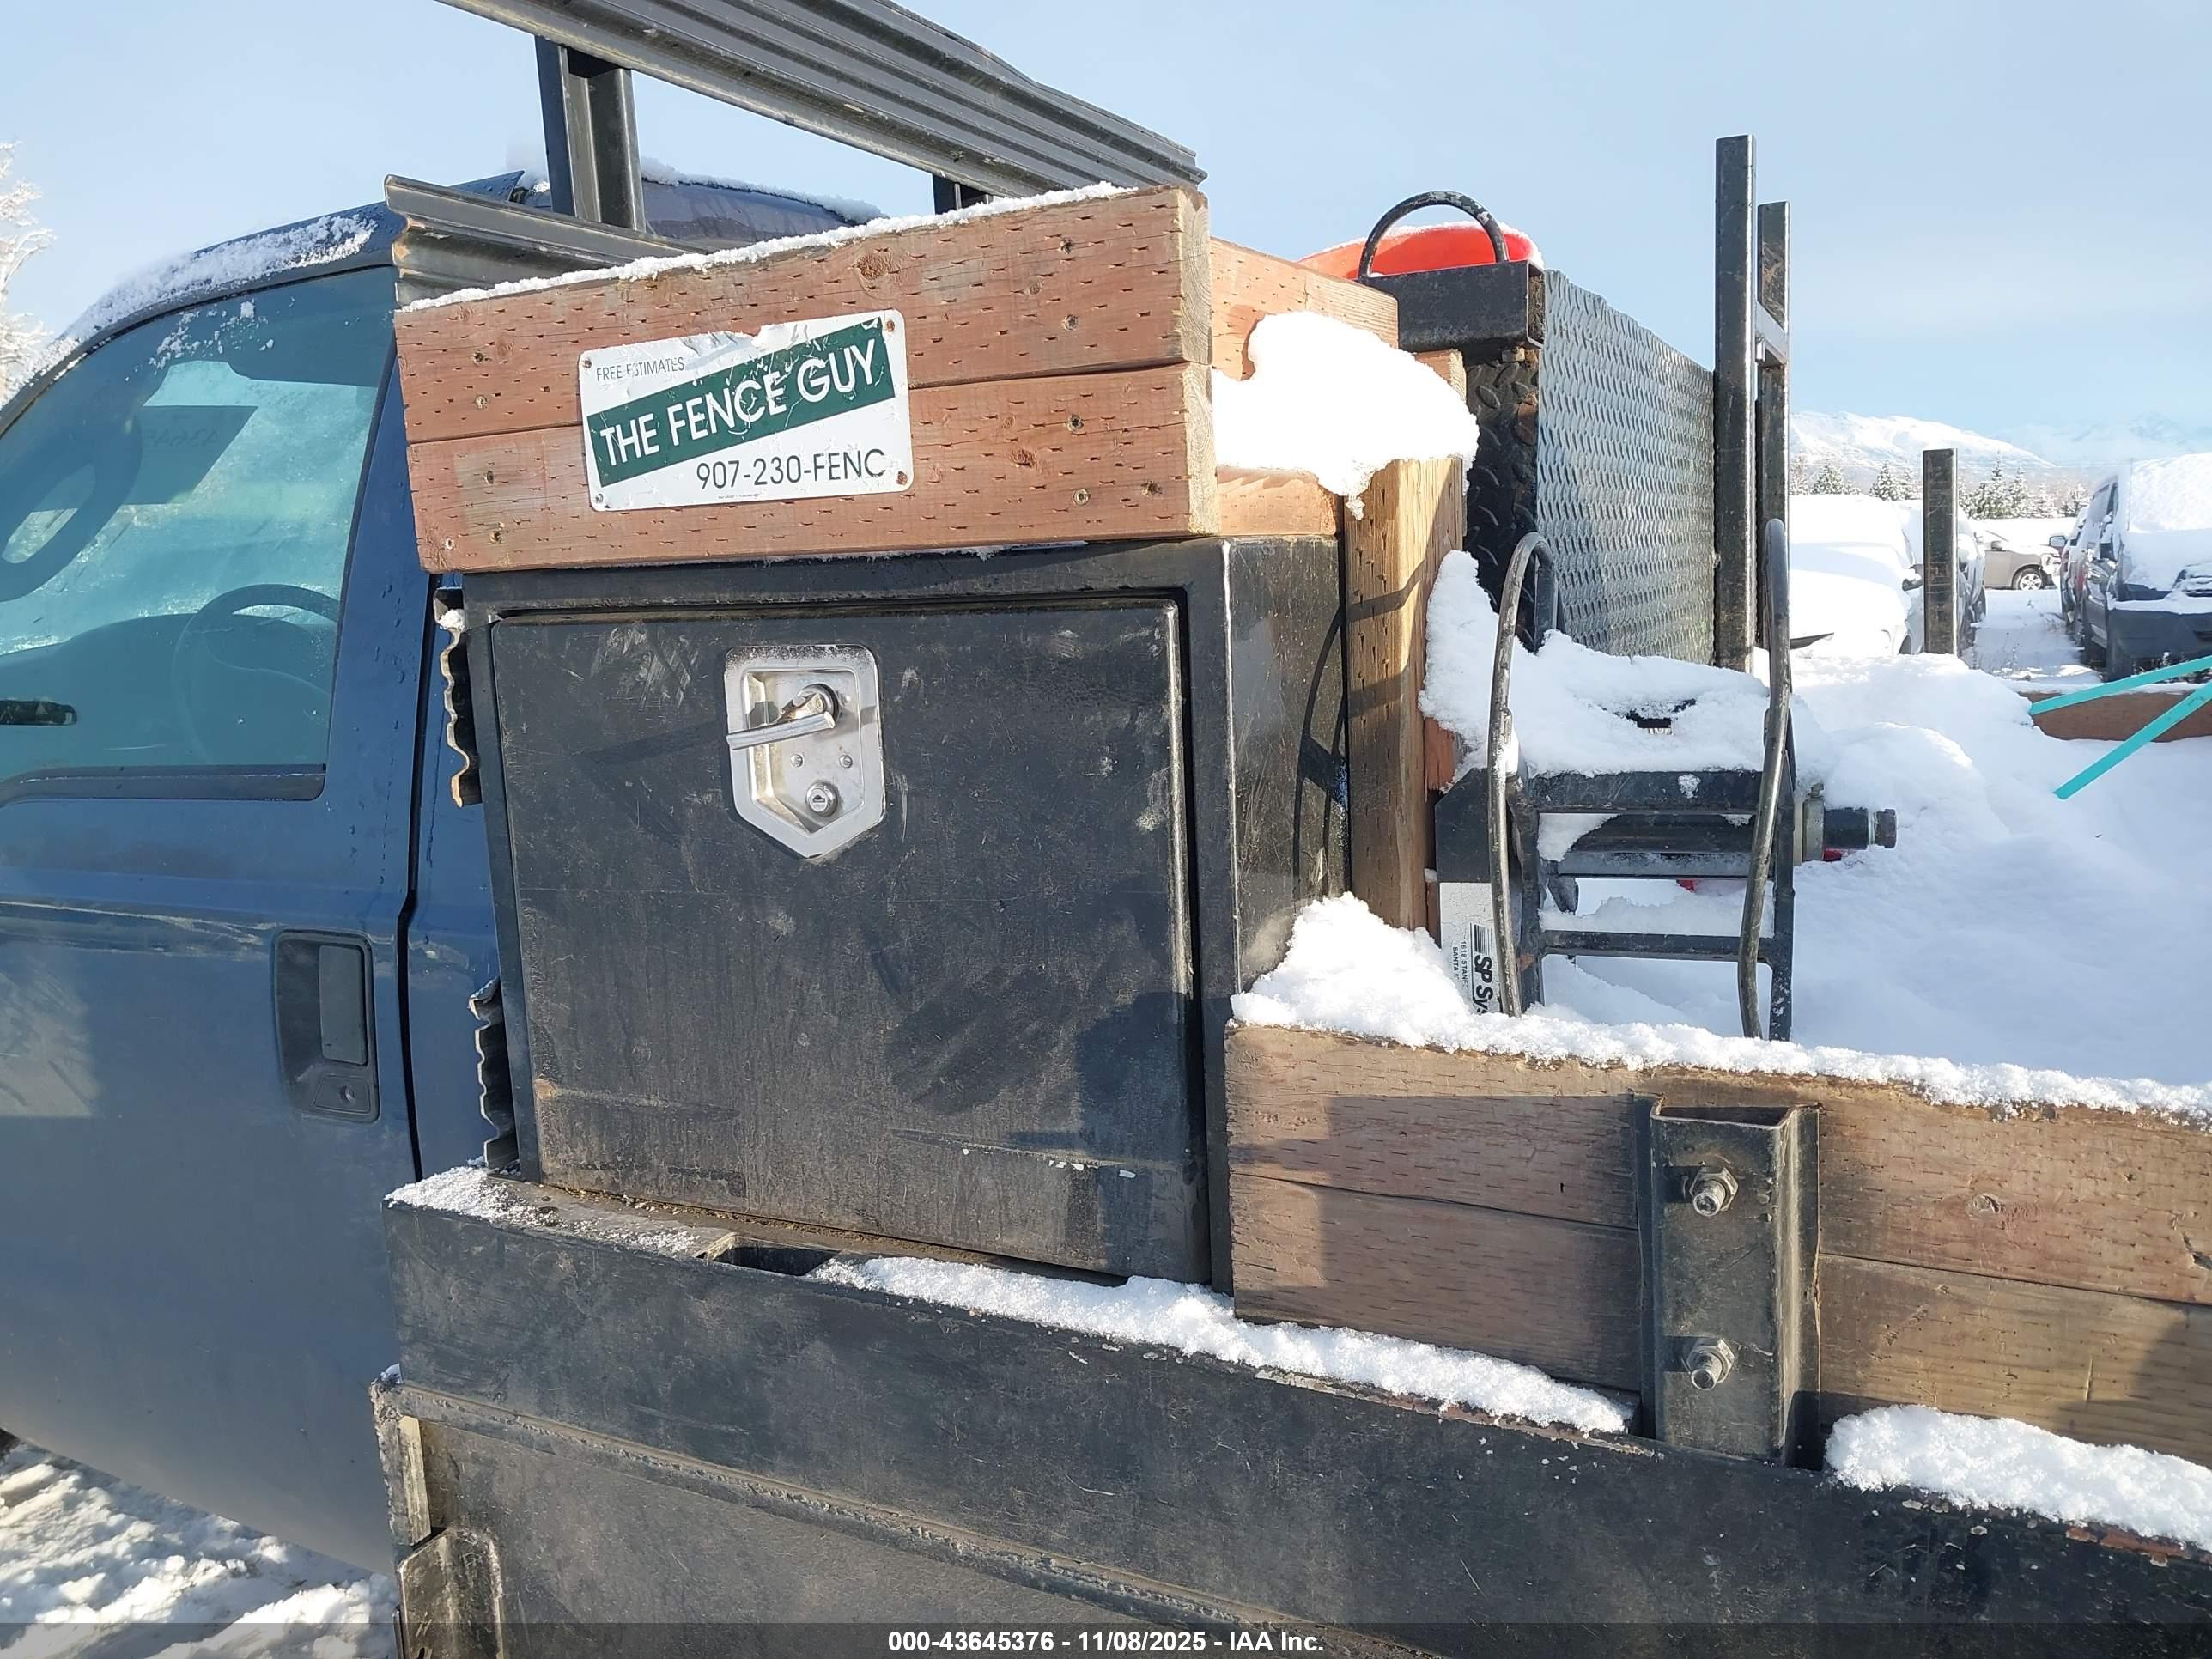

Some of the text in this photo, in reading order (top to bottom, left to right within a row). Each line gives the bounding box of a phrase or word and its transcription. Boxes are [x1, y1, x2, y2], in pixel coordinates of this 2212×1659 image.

[596, 356, 685, 381] FREE ESTIMATES
[599, 338, 877, 466] THE FENCE GUY
[696, 448, 886, 490] 907-230-FENC
[1474, 955, 1492, 983] SP
